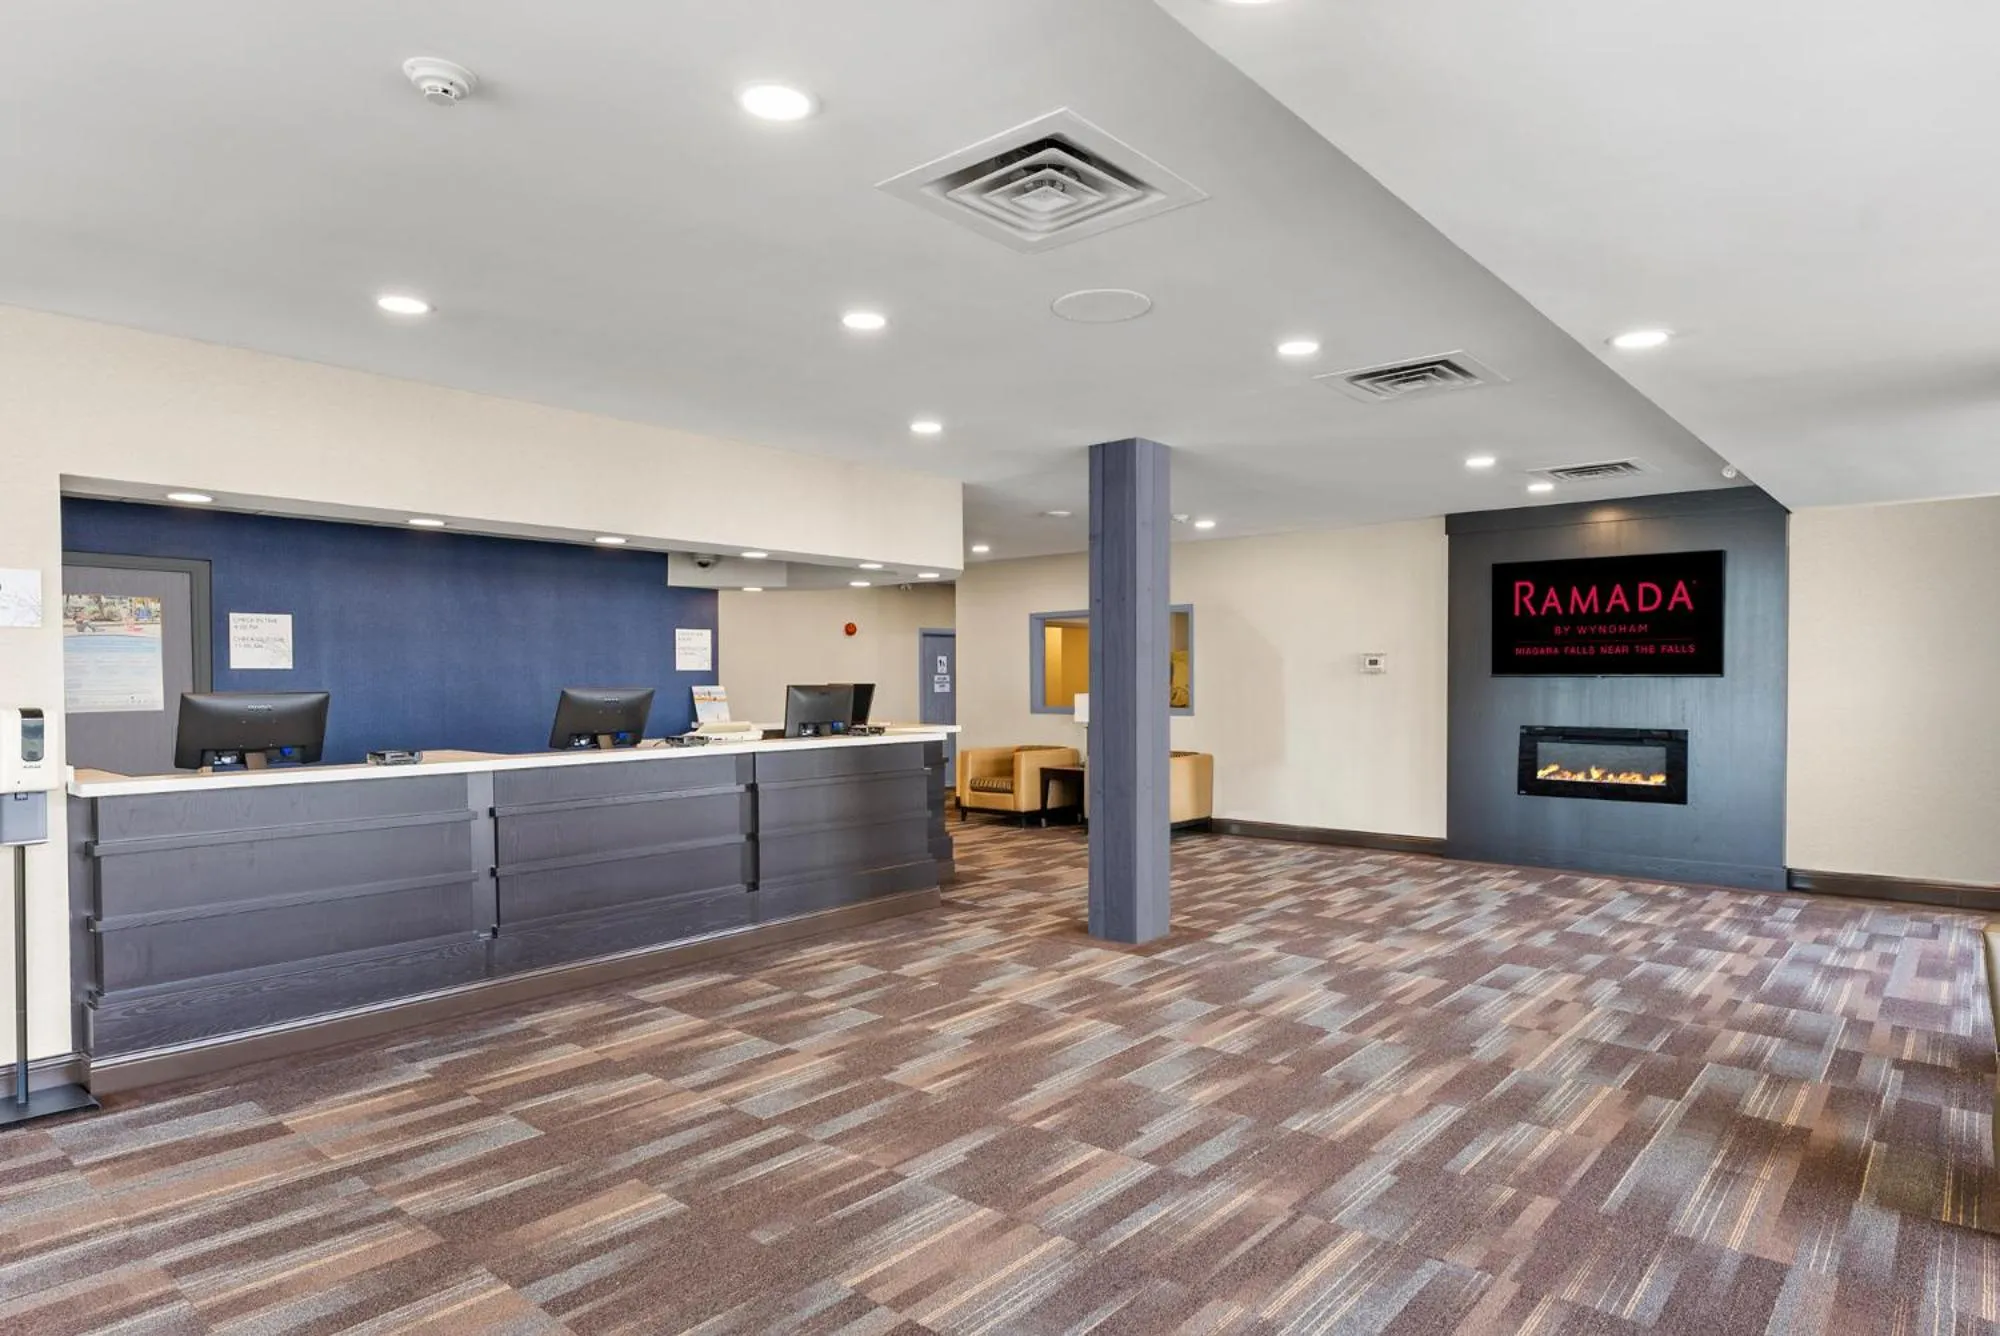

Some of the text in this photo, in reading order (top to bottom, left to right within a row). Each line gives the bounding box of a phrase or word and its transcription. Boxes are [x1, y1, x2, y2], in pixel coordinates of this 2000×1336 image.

[1514, 580, 1694, 616] RAMADA
[1554, 626, 1570, 636] BY
[1515, 643, 1696, 656] NIAGARA FALLS NEAR THE FALLS
